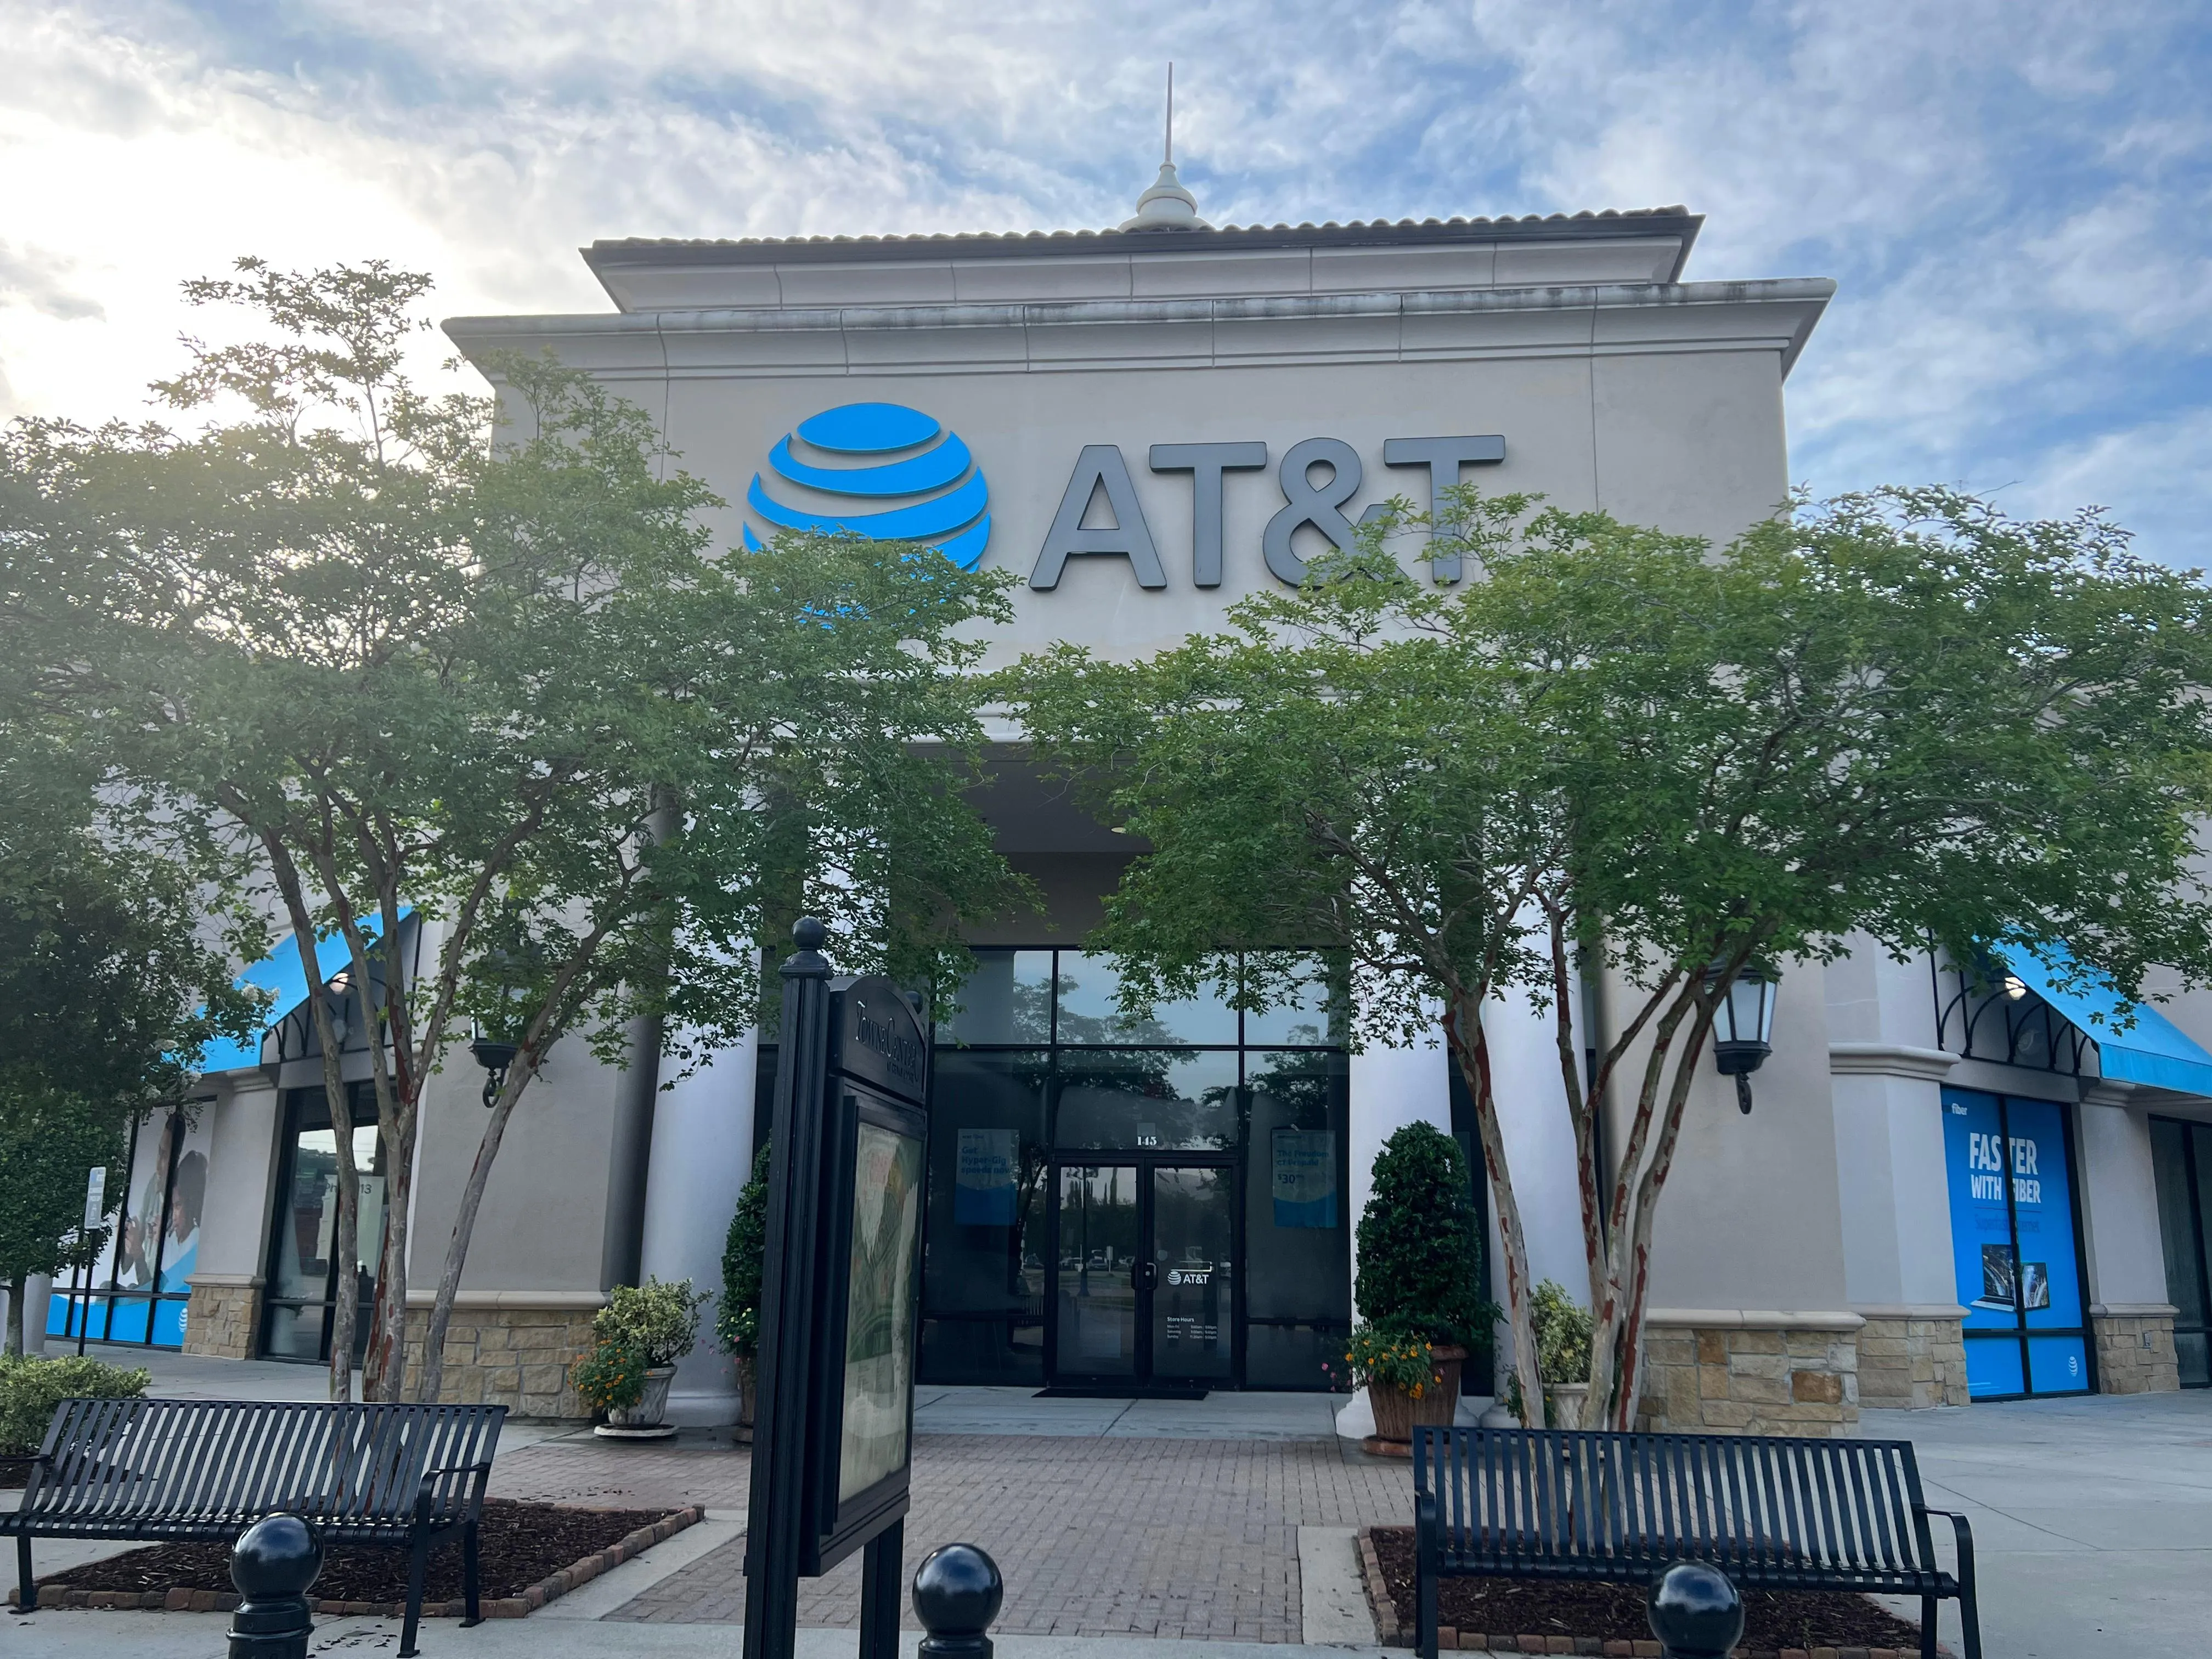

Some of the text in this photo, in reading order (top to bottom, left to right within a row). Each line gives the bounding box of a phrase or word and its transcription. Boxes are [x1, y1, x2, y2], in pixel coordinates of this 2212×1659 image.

[1028, 435, 1506, 591] AT&T
[1137, 1136, 1157, 1146] 145
[962, 1156, 1006, 1166] Hyper-Gig
[961, 1165, 991, 1175] speeds
[1278, 1173, 1295, 1184] $30
[360, 1184, 372, 1194] 13
[1971, 1174, 2002, 1200] WITH
[1183, 1274, 1209, 1284] AT&T
